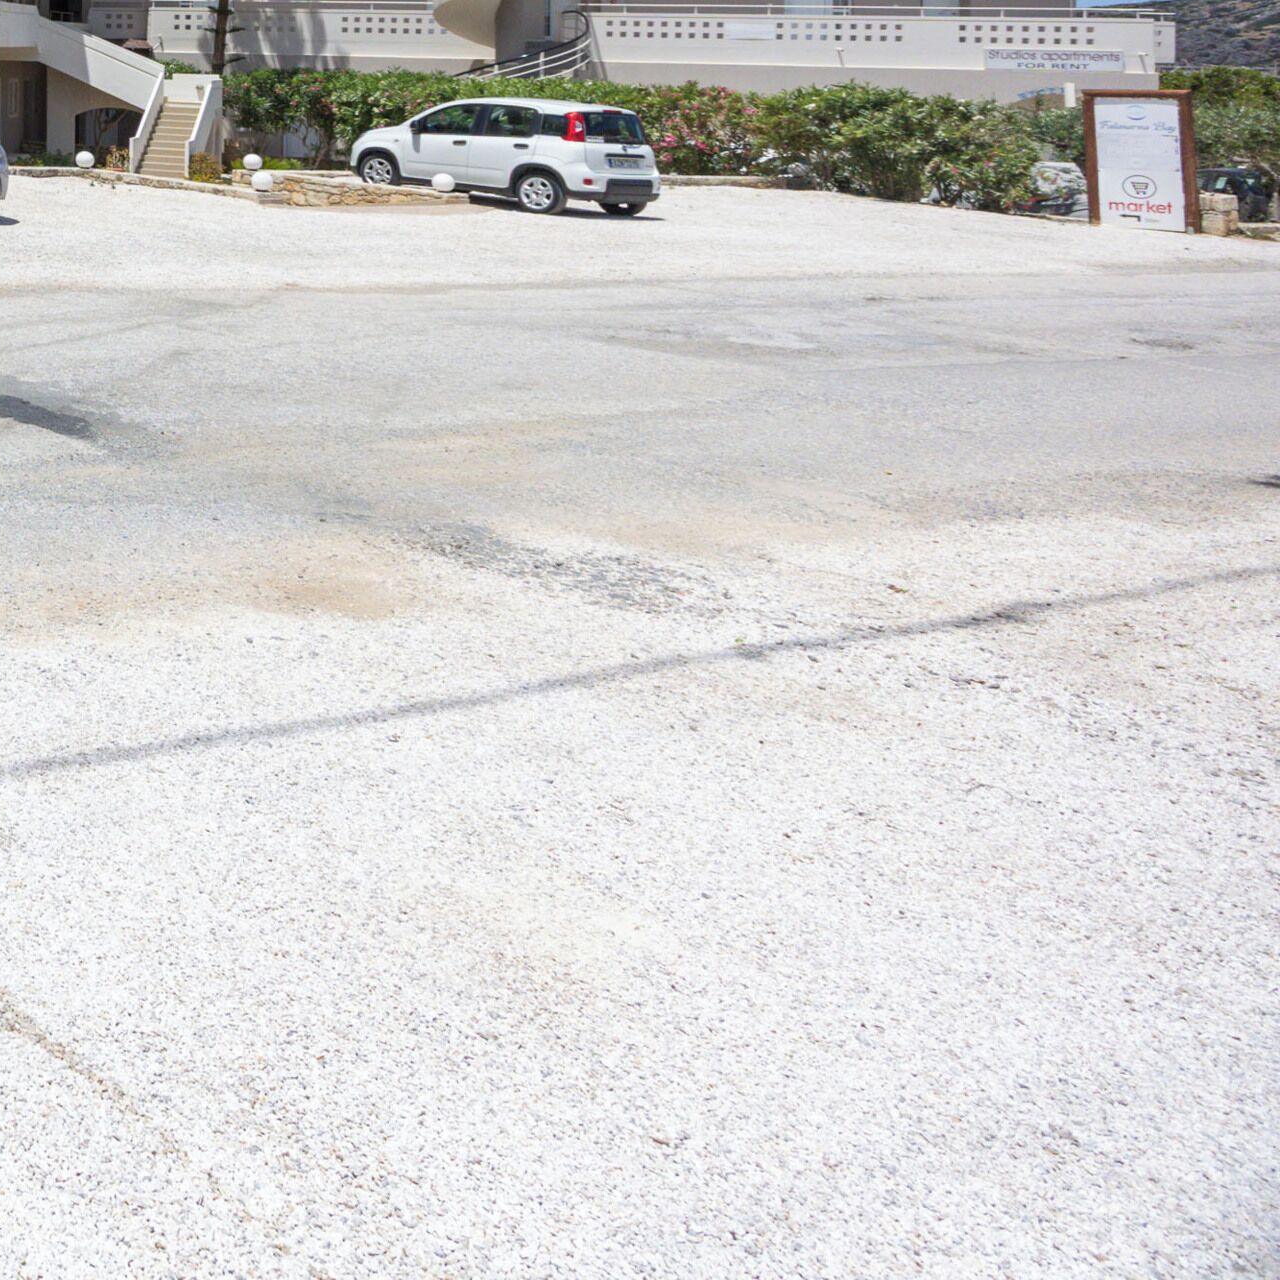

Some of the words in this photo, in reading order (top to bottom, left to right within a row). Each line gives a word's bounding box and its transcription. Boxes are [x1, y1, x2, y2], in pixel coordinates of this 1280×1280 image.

[988, 49, 1036, 61] Studios
[1040, 50, 1121, 62] apartments
[1051, 62, 1090, 70] RENT
[1108, 201, 1173, 214] market
